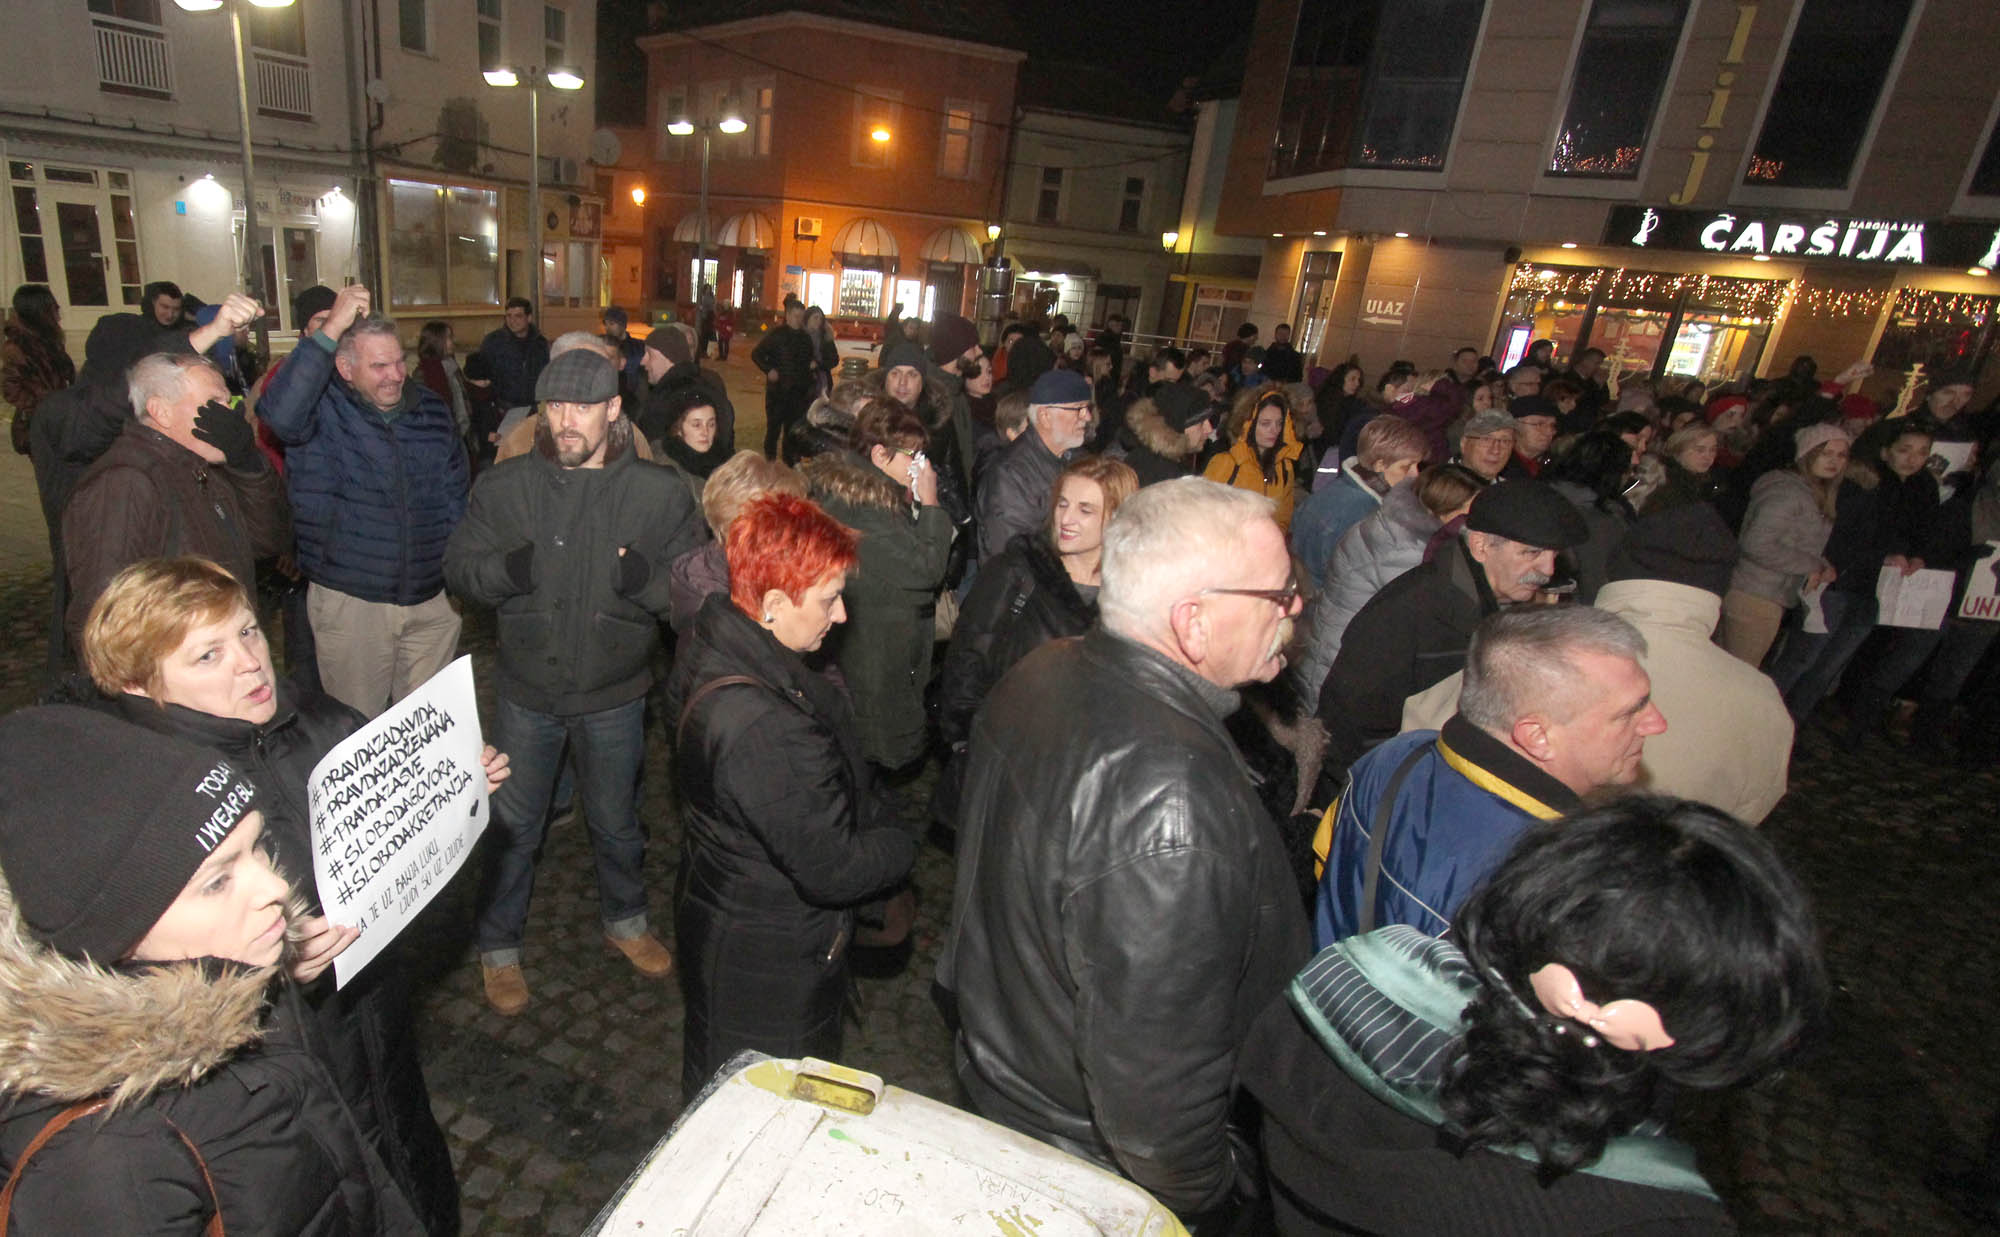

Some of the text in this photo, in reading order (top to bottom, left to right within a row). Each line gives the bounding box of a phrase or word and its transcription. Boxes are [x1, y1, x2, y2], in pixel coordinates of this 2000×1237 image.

[1700, 213, 1924, 264] ČARŠIJA
[1900, 222, 1924, 232] BAR
[1366, 299, 1405, 316] ULAZ
[195, 760, 234, 799] TODAY
[369, 902, 379, 921] JE
[381, 887, 394, 910] UZ
[395, 860, 420, 895] BANJA
[418, 837, 439, 869] LUKU
[399, 884, 419, 914] LJUDI
[422, 870, 432, 890] SU
[433, 857, 443, 876] UZ
